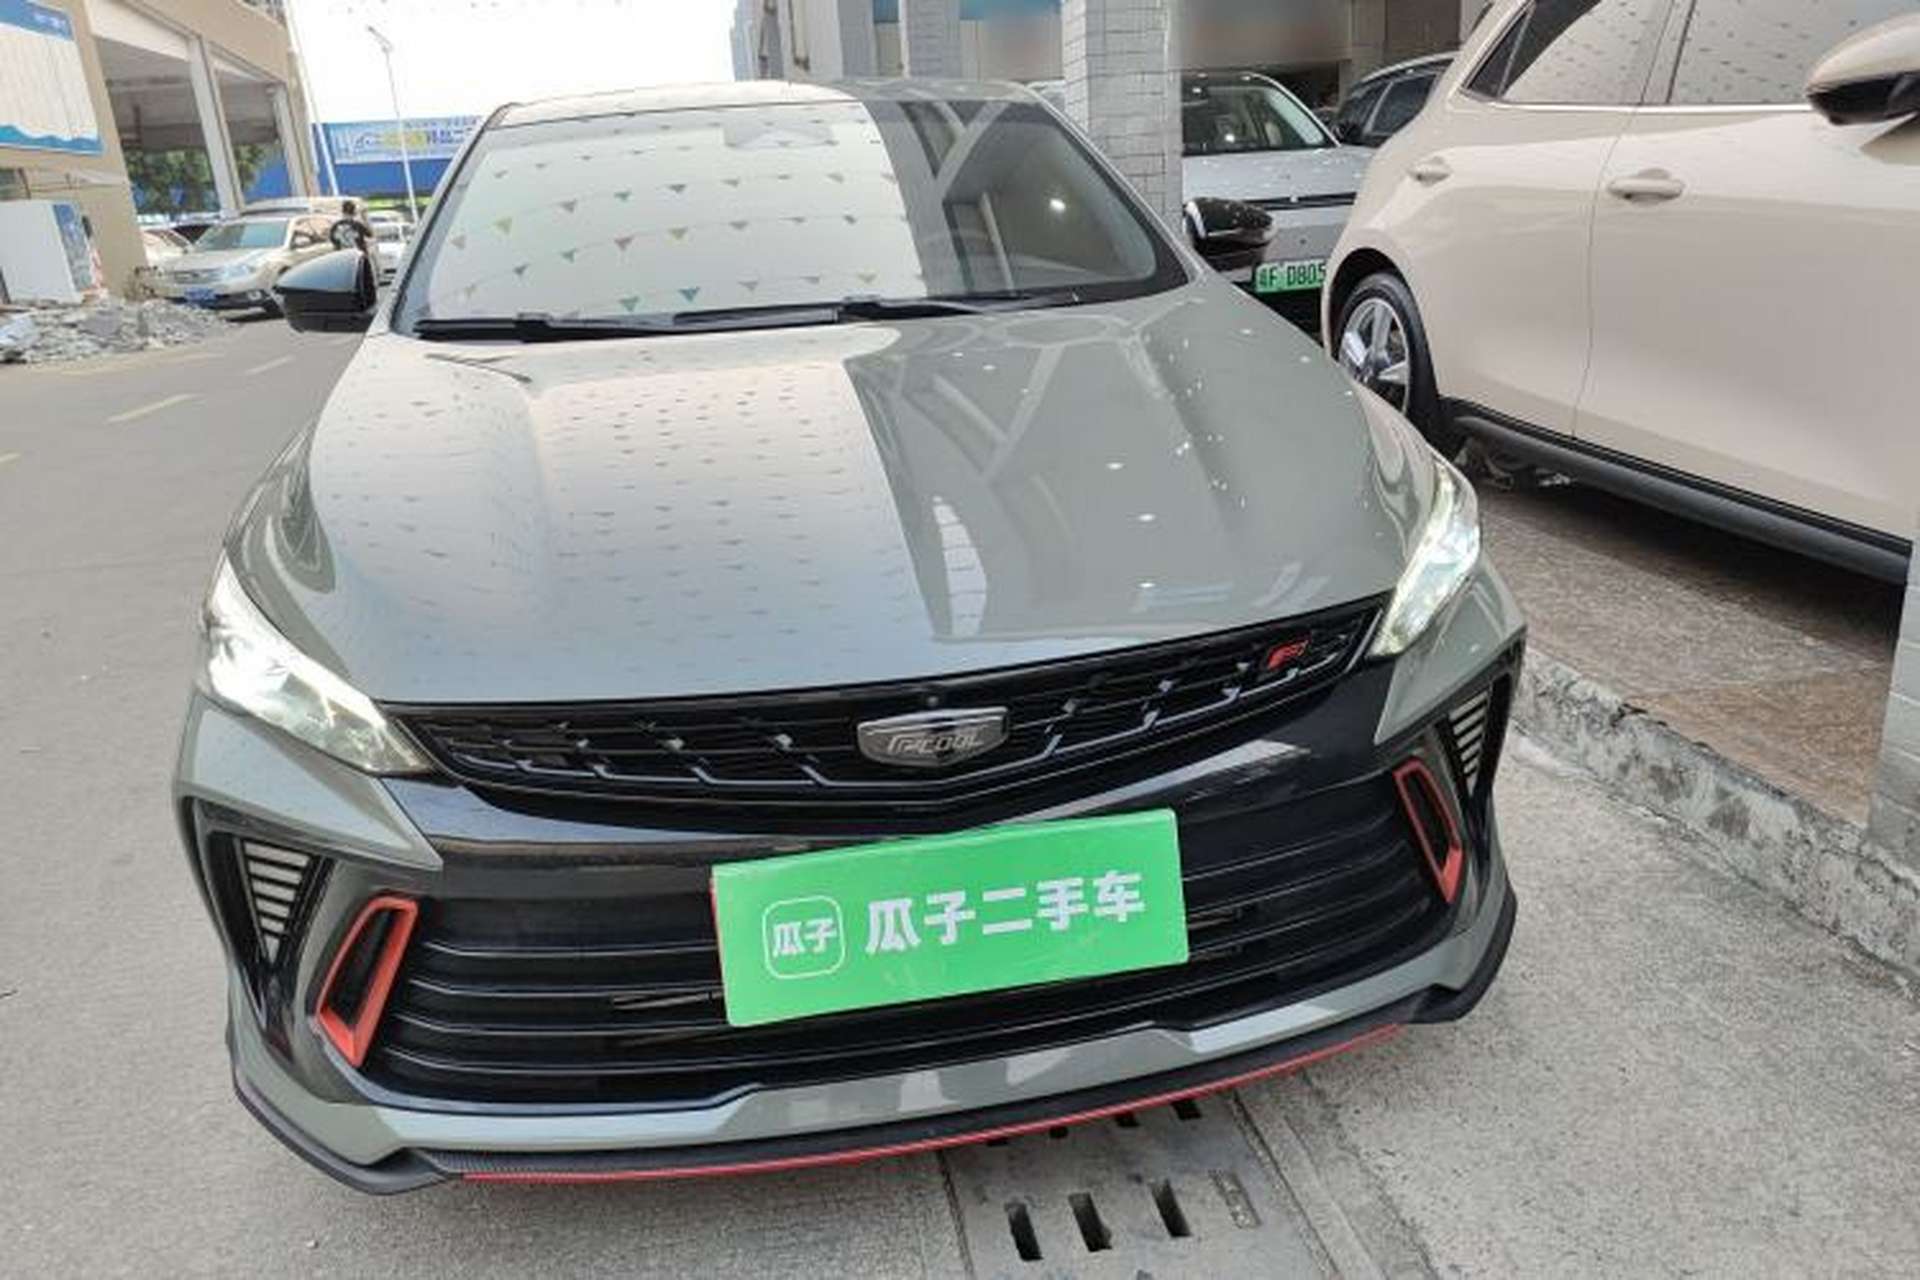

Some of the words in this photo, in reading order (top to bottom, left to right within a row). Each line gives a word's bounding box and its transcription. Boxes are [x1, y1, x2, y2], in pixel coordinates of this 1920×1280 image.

[772, 919, 838, 957] 瓜子
[865, 871, 1146, 954] 瓜子二手车
